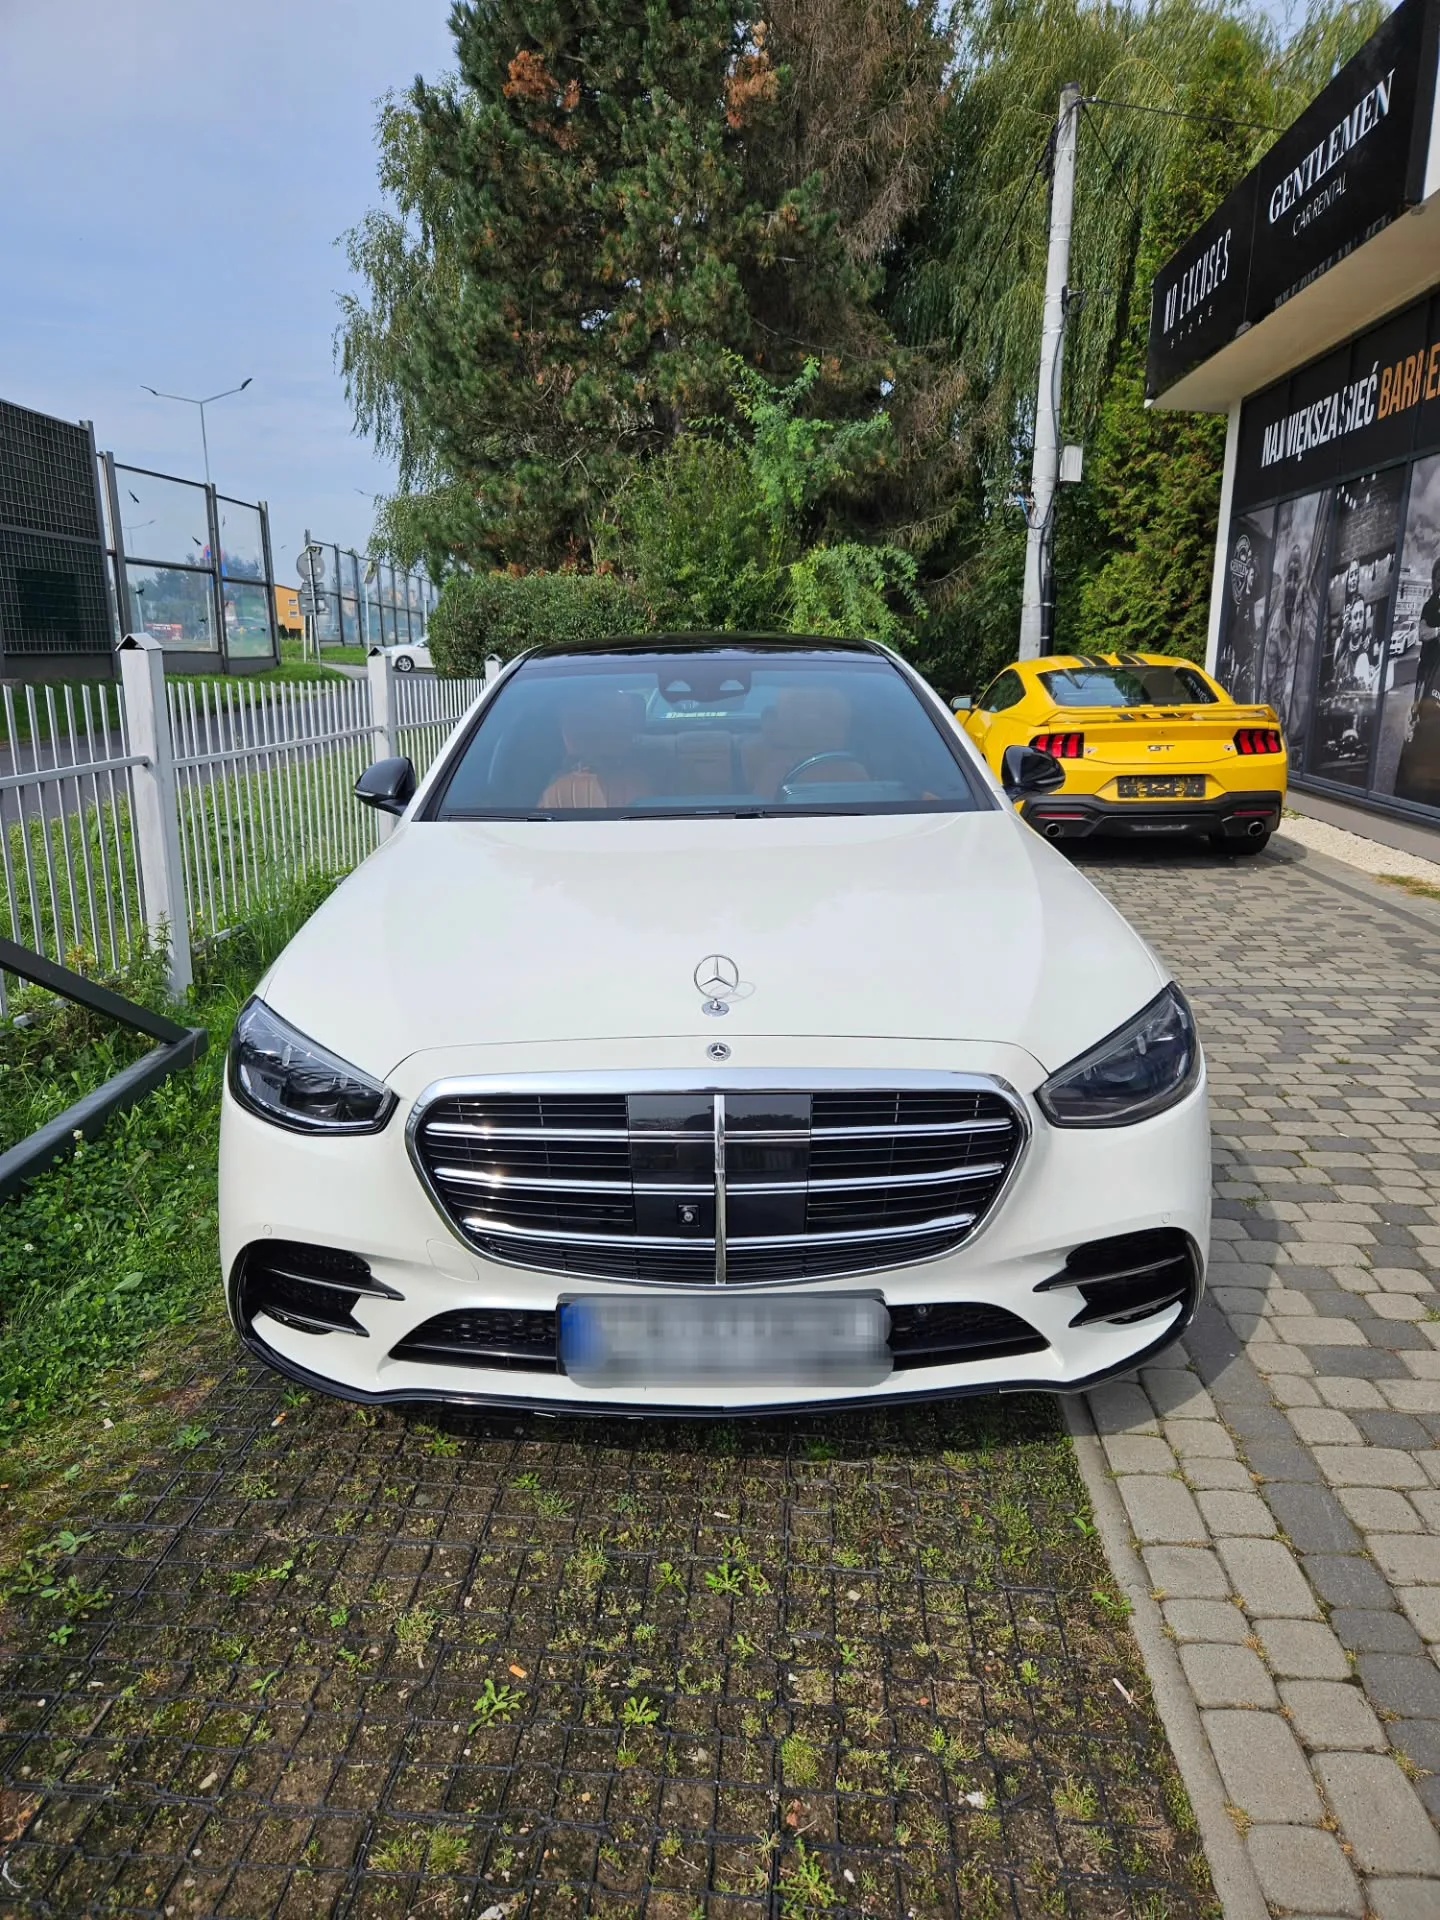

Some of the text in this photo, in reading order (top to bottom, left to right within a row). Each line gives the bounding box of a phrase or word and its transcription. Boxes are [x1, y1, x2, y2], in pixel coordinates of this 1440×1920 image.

[1269, 67, 1396, 225] GENTLEMEN
[1292, 171, 1348, 237] CAR RENTAL
[1163, 283, 1178, 335] NO
[1179, 228, 1232, 321] EXCUSES
[1376, 342, 1440, 421] BARBE
[1147, 744, 1176, 752] GT
